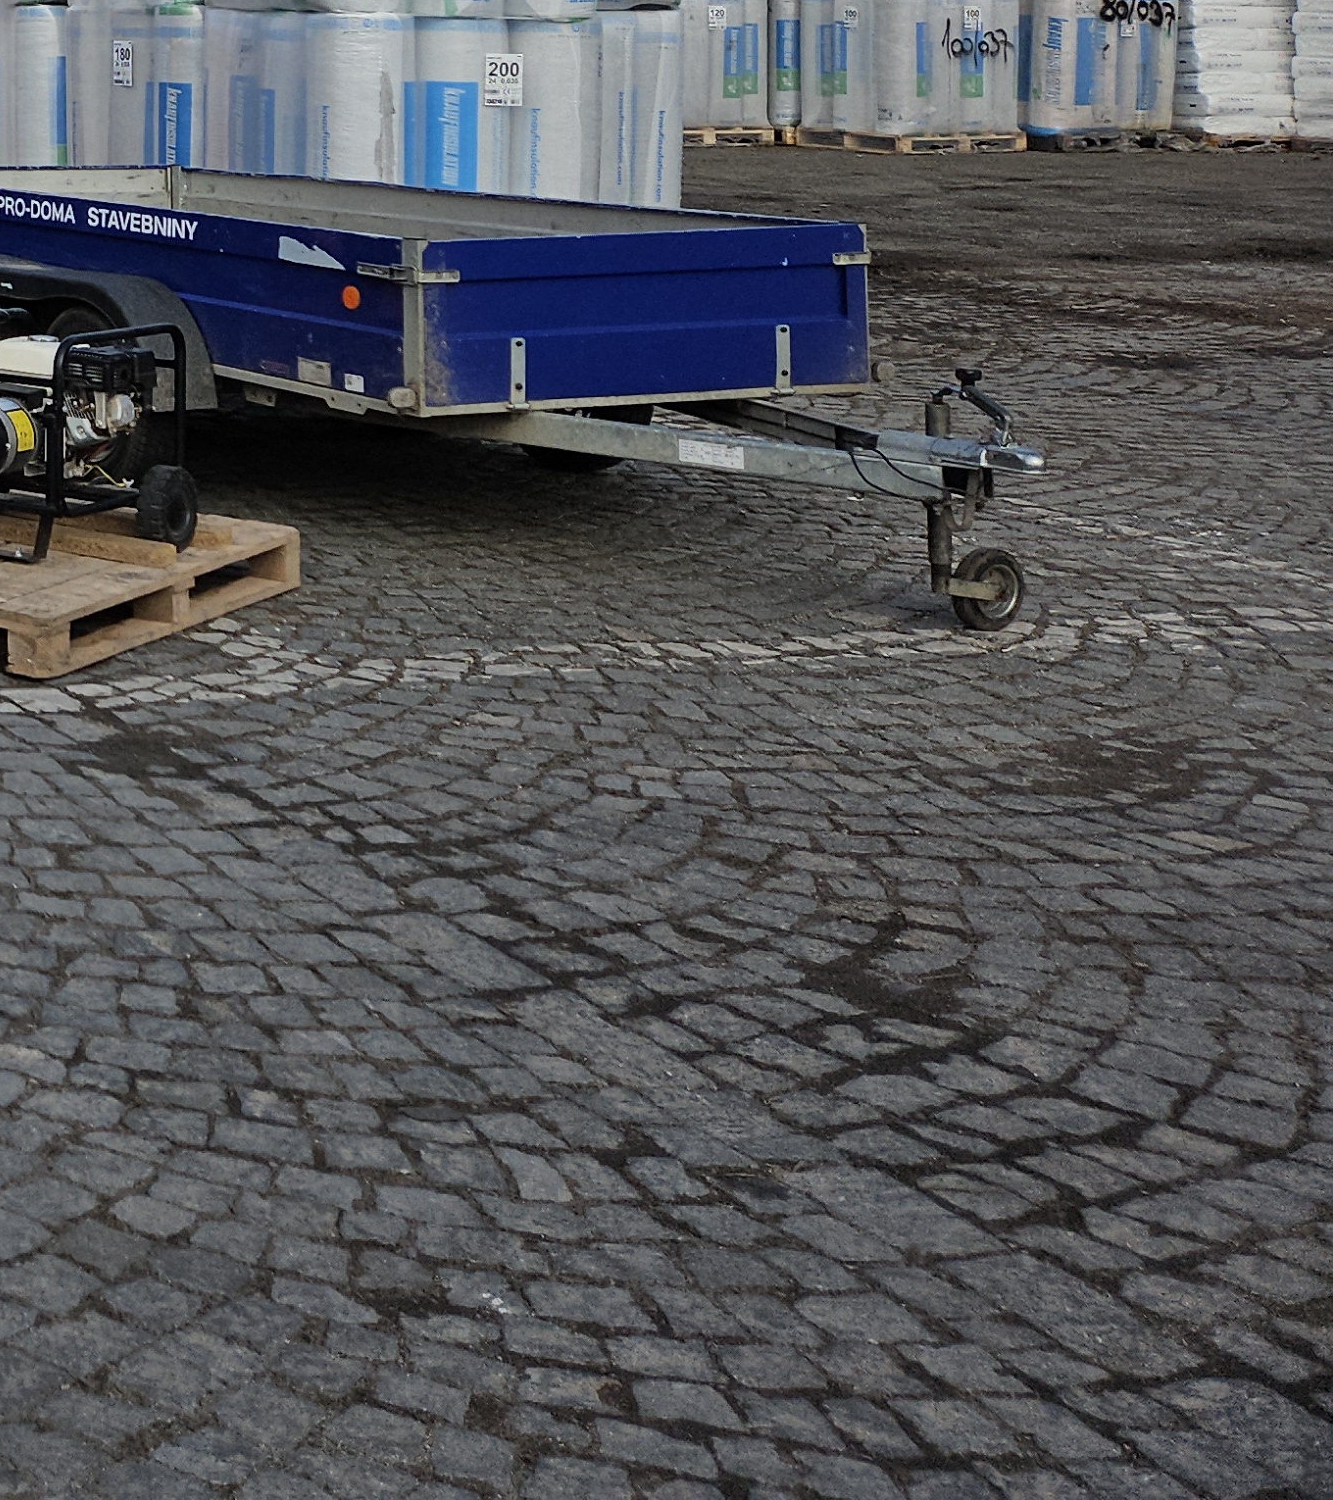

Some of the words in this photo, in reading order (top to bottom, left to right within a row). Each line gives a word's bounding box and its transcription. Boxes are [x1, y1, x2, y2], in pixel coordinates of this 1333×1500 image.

[710, 9, 725, 17] 120
[1042, 16, 1069, 51] KNAUF
[115, 47, 131, 61] 180
[488, 61, 520, 77] 200
[87, 206, 198, 241] STAVEBNINY
